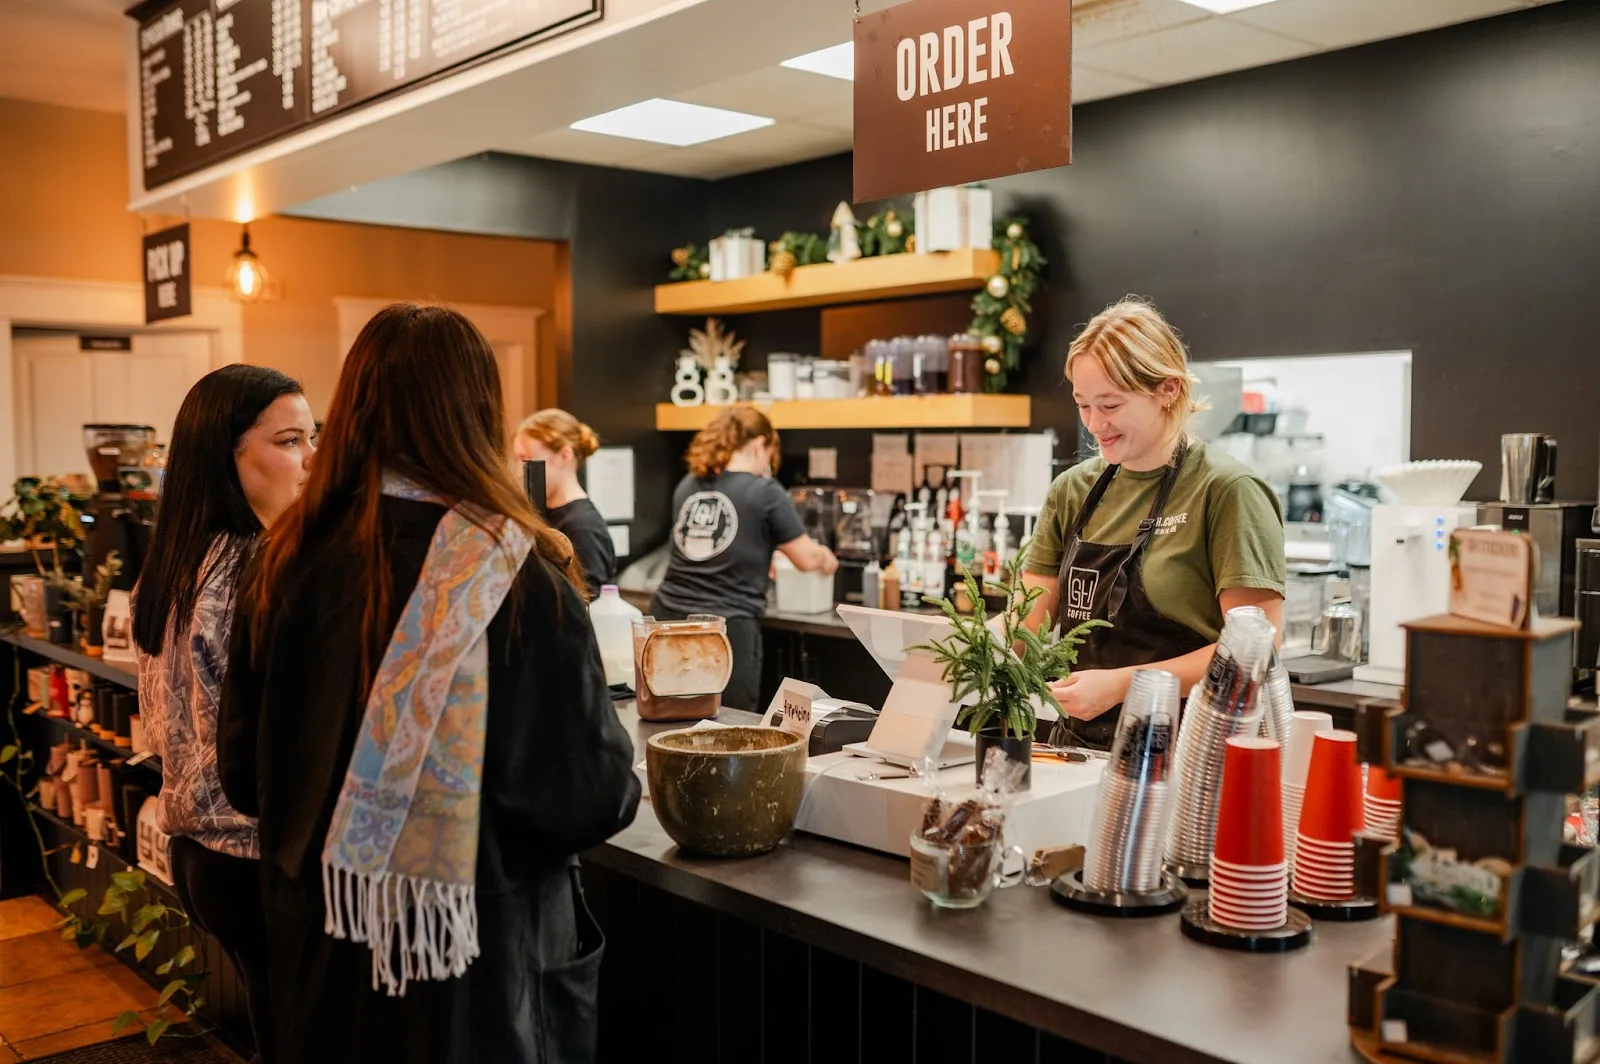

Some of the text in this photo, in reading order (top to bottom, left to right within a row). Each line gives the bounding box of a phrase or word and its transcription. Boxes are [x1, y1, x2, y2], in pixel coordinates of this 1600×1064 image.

[896, 11, 1015, 102] ORDER
[926, 97, 988, 152] HERE
[1067, 608, 1092, 620] COFFEE
